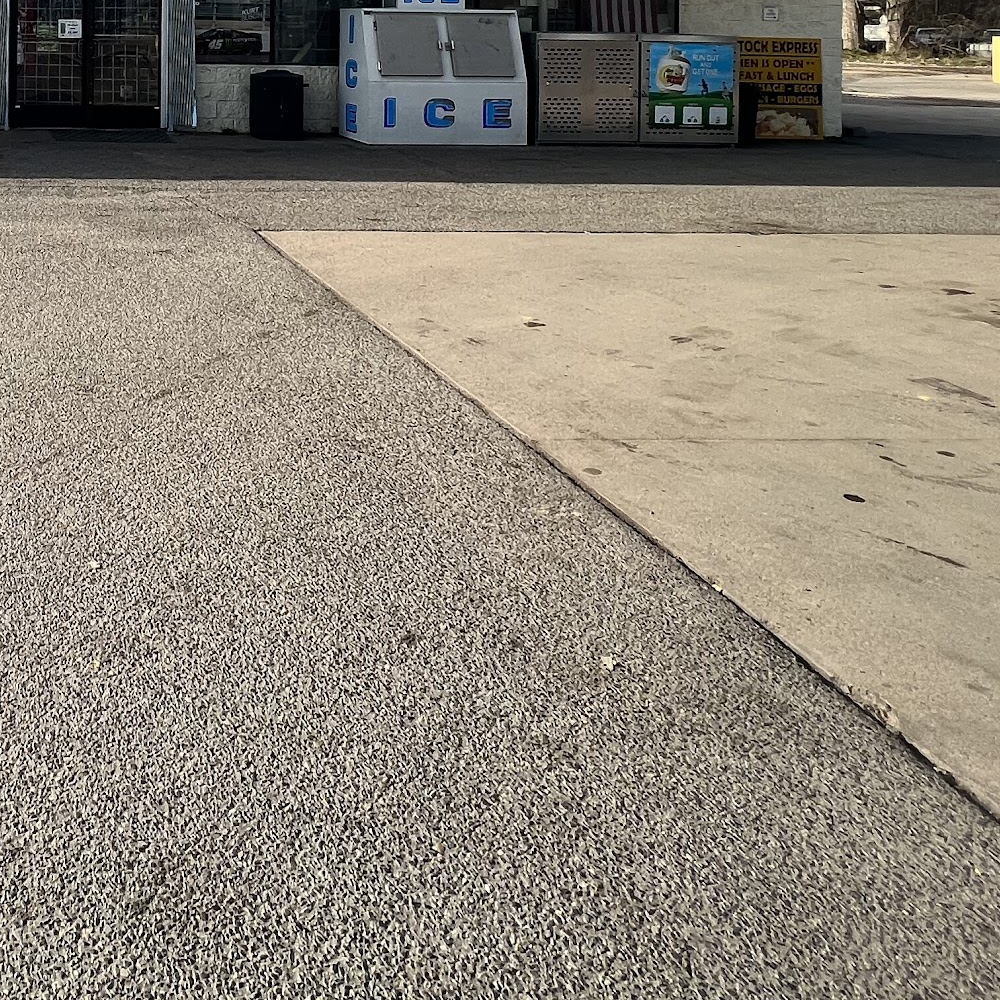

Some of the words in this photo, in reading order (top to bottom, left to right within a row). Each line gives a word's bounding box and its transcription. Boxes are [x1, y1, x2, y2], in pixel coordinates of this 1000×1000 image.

[772, 41, 820, 54] EXPRESS
[762, 59, 769, 68] IS
[773, 60, 804, 69] OPEN
[345, 14, 358, 133] ICE
[766, 72, 774, 81] &
[777, 72, 815, 81] LUNCH
[794, 84, 818, 93] EGGS
[777, 95, 820, 104] BURGERS
[383, 97, 513, 129] ICE
